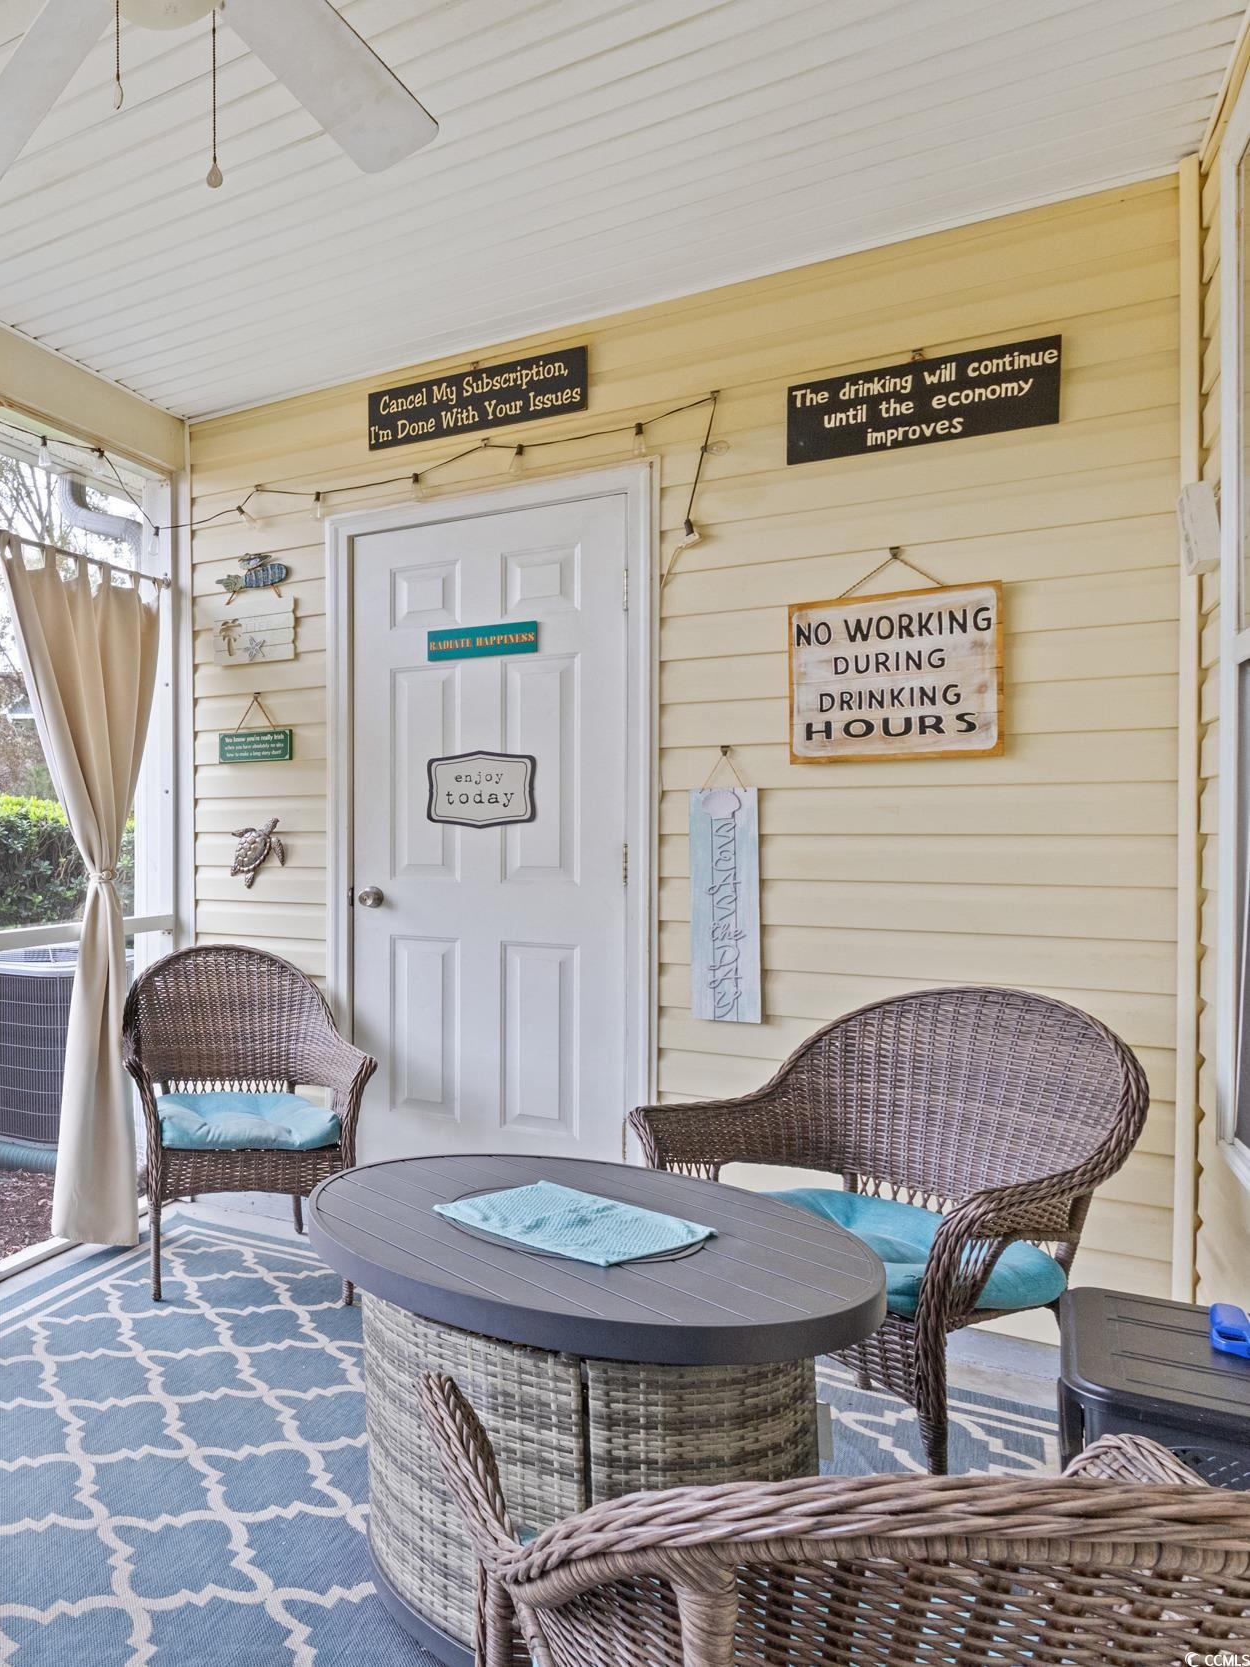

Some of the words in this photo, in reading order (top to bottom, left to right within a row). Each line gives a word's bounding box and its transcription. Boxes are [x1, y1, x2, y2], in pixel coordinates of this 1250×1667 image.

[379, 388, 427, 415] Cancel
[432, 383, 456, 404] My
[462, 360, 569, 397] Subscription,
[792, 389, 829, 408] The
[839, 374, 912, 401] drinking
[923, 362, 956, 385] will
[967, 348, 1058, 377] continue
[370, 426, 392, 444] I'm
[397, 418, 436, 439] Done
[441, 407, 479, 429] With
[484, 399, 523, 419] Your
[529, 387, 581, 411] Issues
[823, 405, 866, 428] until
[879, 401, 914, 418] the
[931, 378, 1033, 409] economy
[866, 416, 964, 447] improves
[795, 621, 832, 647] NO
[844, 606, 992, 643] WORKING
[429, 638, 472, 651] RADIATE
[476, 632, 535, 647] HAPPINESS
[833, 648, 946, 675] DURING
[819, 684, 961, 712] DRINKING
[805, 712, 977, 741] HOURS
[454, 771, 504, 785] enjoy
[445, 790, 515, 807] today
[710, 923, 746, 941] the
